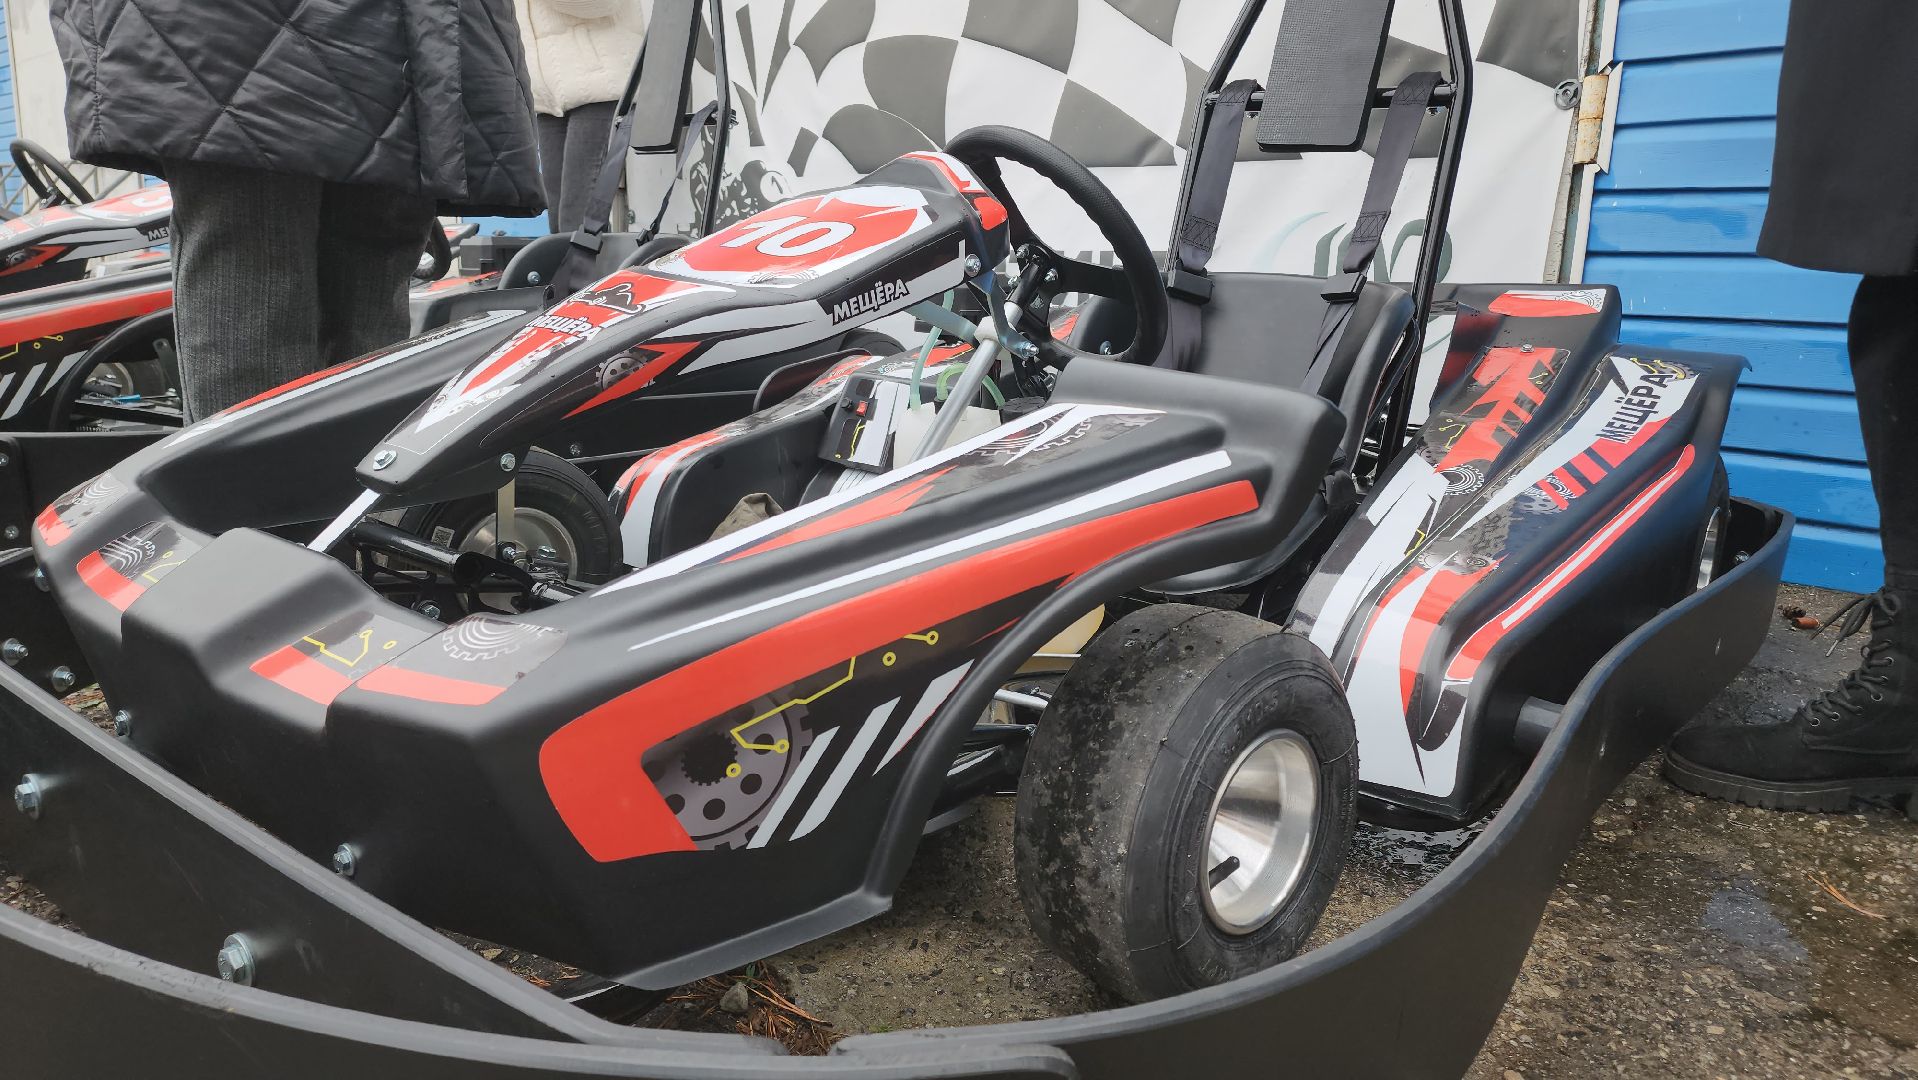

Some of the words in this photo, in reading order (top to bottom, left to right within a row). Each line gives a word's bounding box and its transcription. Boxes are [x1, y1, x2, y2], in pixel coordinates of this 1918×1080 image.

[719, 215, 857, 257] 10
[832, 278, 910, 326] МЕЩЁРА
[526, 314, 602, 342] МЕЩЁРА
[1595, 374, 1675, 443] МЕЩЁРА
